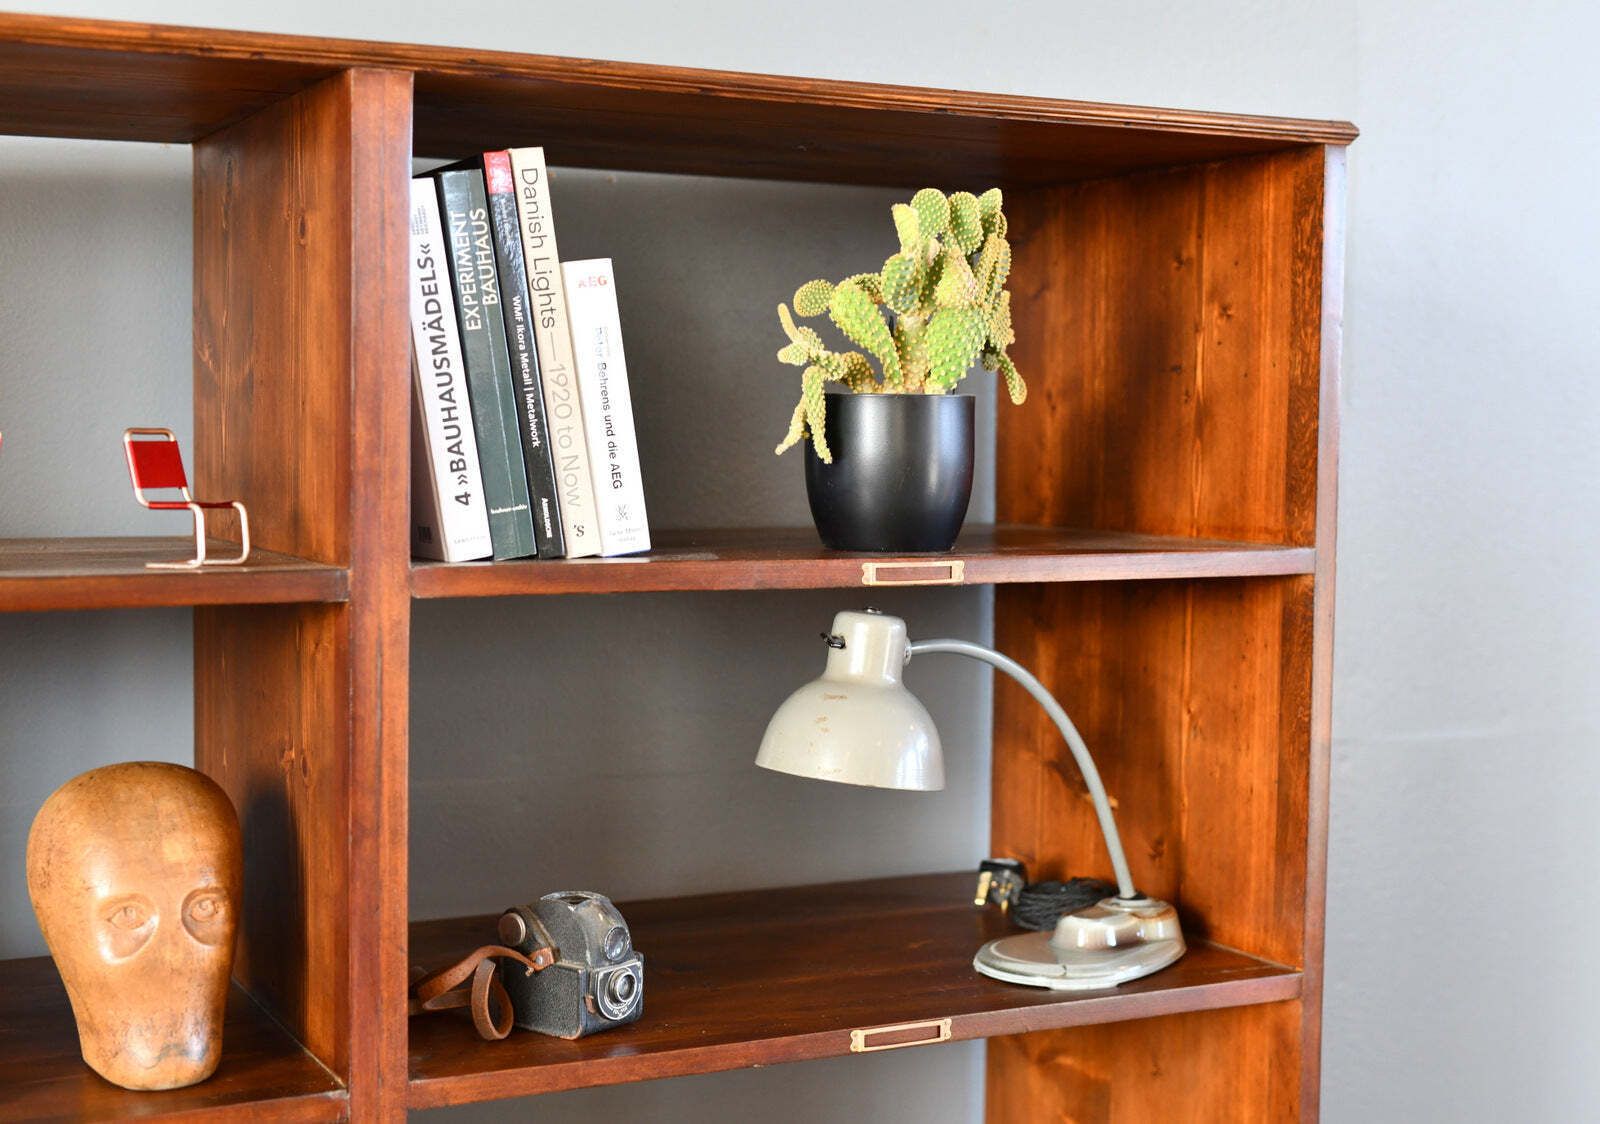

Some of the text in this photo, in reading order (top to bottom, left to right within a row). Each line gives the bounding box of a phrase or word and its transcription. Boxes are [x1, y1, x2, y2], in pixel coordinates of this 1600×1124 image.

[521, 167, 548, 249] Danish
[451, 210, 482, 331] EXPERIMENT
[469, 208, 499, 305] BAUHAUS
[531, 257, 556, 329] Lights
[578, 274, 607, 289] AEG
[511, 295, 524, 322] WMF
[516, 324, 527, 351] Ikora
[519, 352, 533, 385] Metall
[549, 363, 573, 420] 1920
[525, 393, 541, 449] Metalwork
[604, 414, 616, 437] und
[557, 425, 574, 449] to
[607, 441, 618, 460] die
[560, 454, 582, 507] Now
[610, 463, 623, 490] AEG
[454, 491, 471, 506] 4
